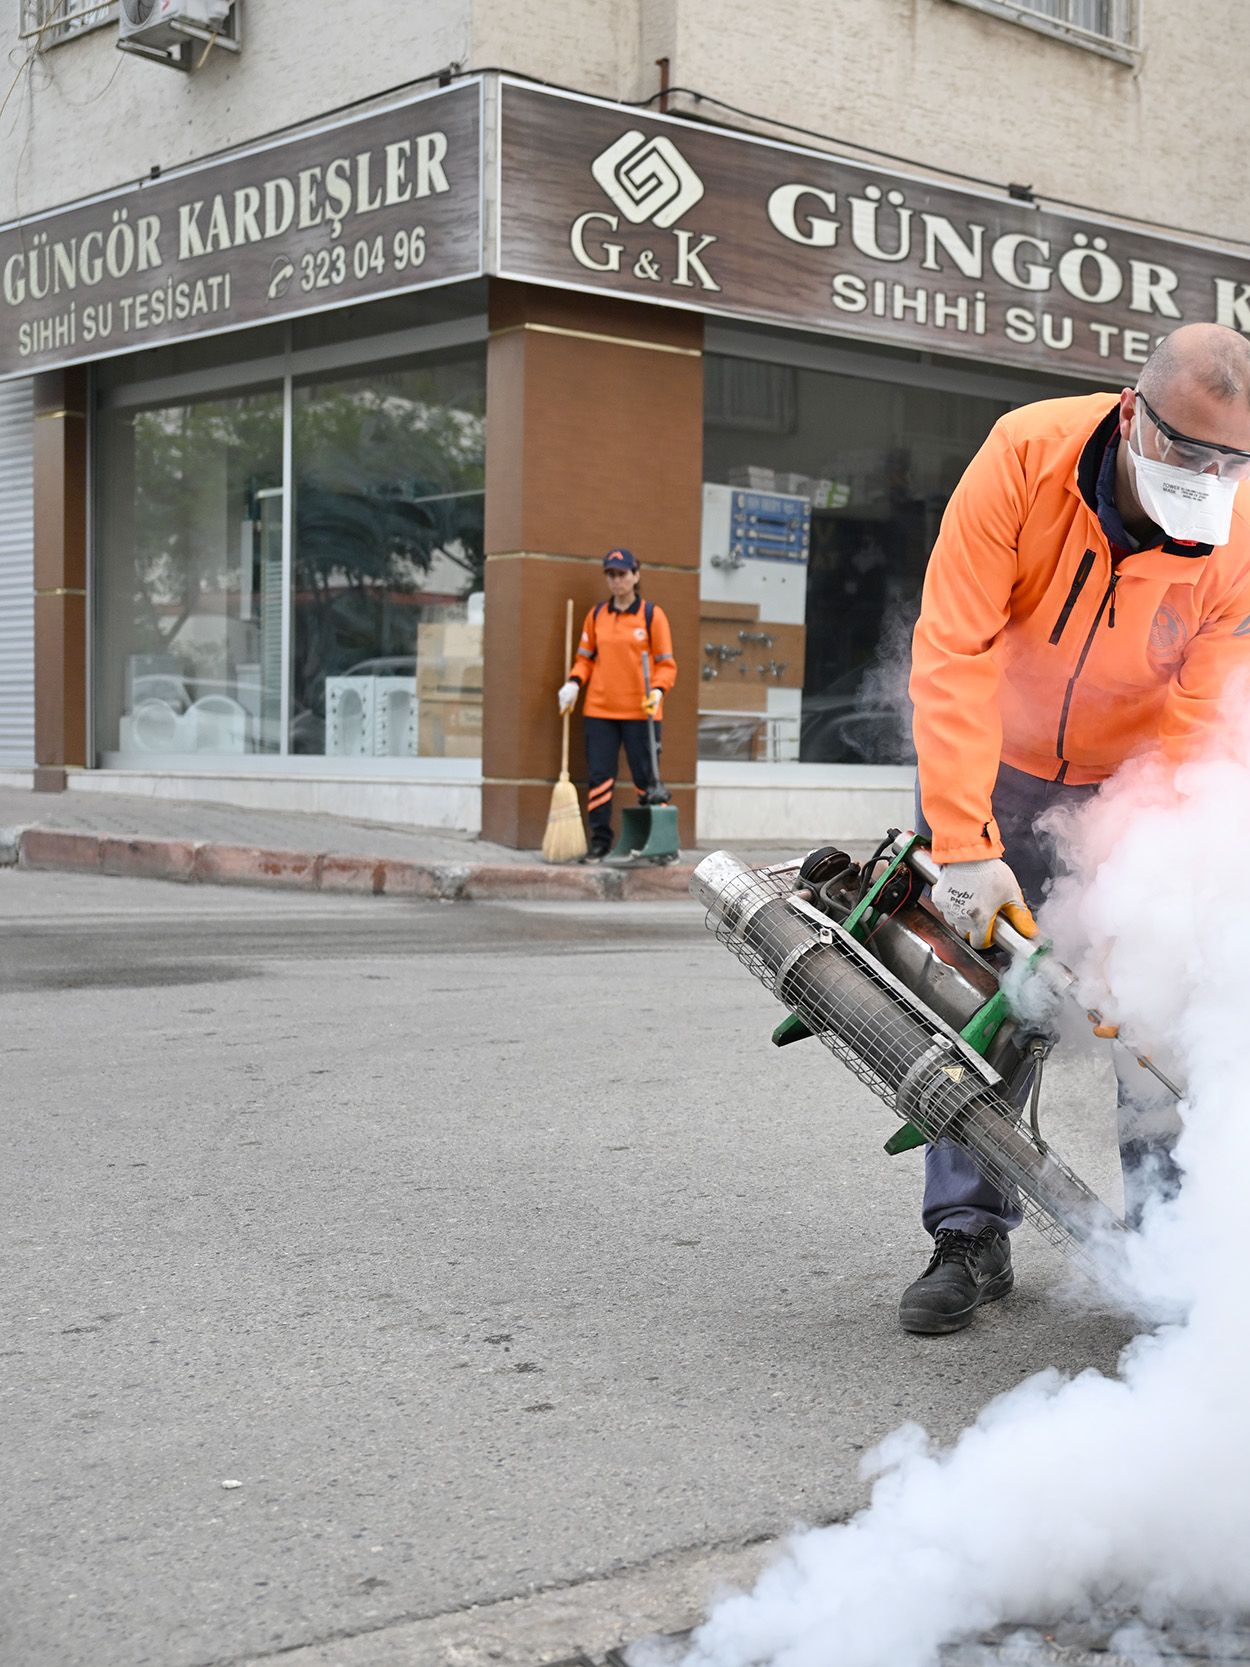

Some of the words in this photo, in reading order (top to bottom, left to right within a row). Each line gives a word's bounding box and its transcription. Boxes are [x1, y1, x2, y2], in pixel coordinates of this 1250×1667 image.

[4, 207, 162, 306] GÜNGÖR
[178, 131, 451, 261] KARDEŞLER
[300, 245, 347, 292] 323
[353, 235, 385, 280] 04
[393, 226, 427, 271] 96
[767, 184, 1183, 319] GÜNGÖR
[18, 311, 77, 357] SIHHİ
[82, 309, 113, 342] SU
[120, 273, 232, 333] TESİSATI
[832, 273, 986, 336] SIHHİ
[1005, 306, 1074, 350] SU
